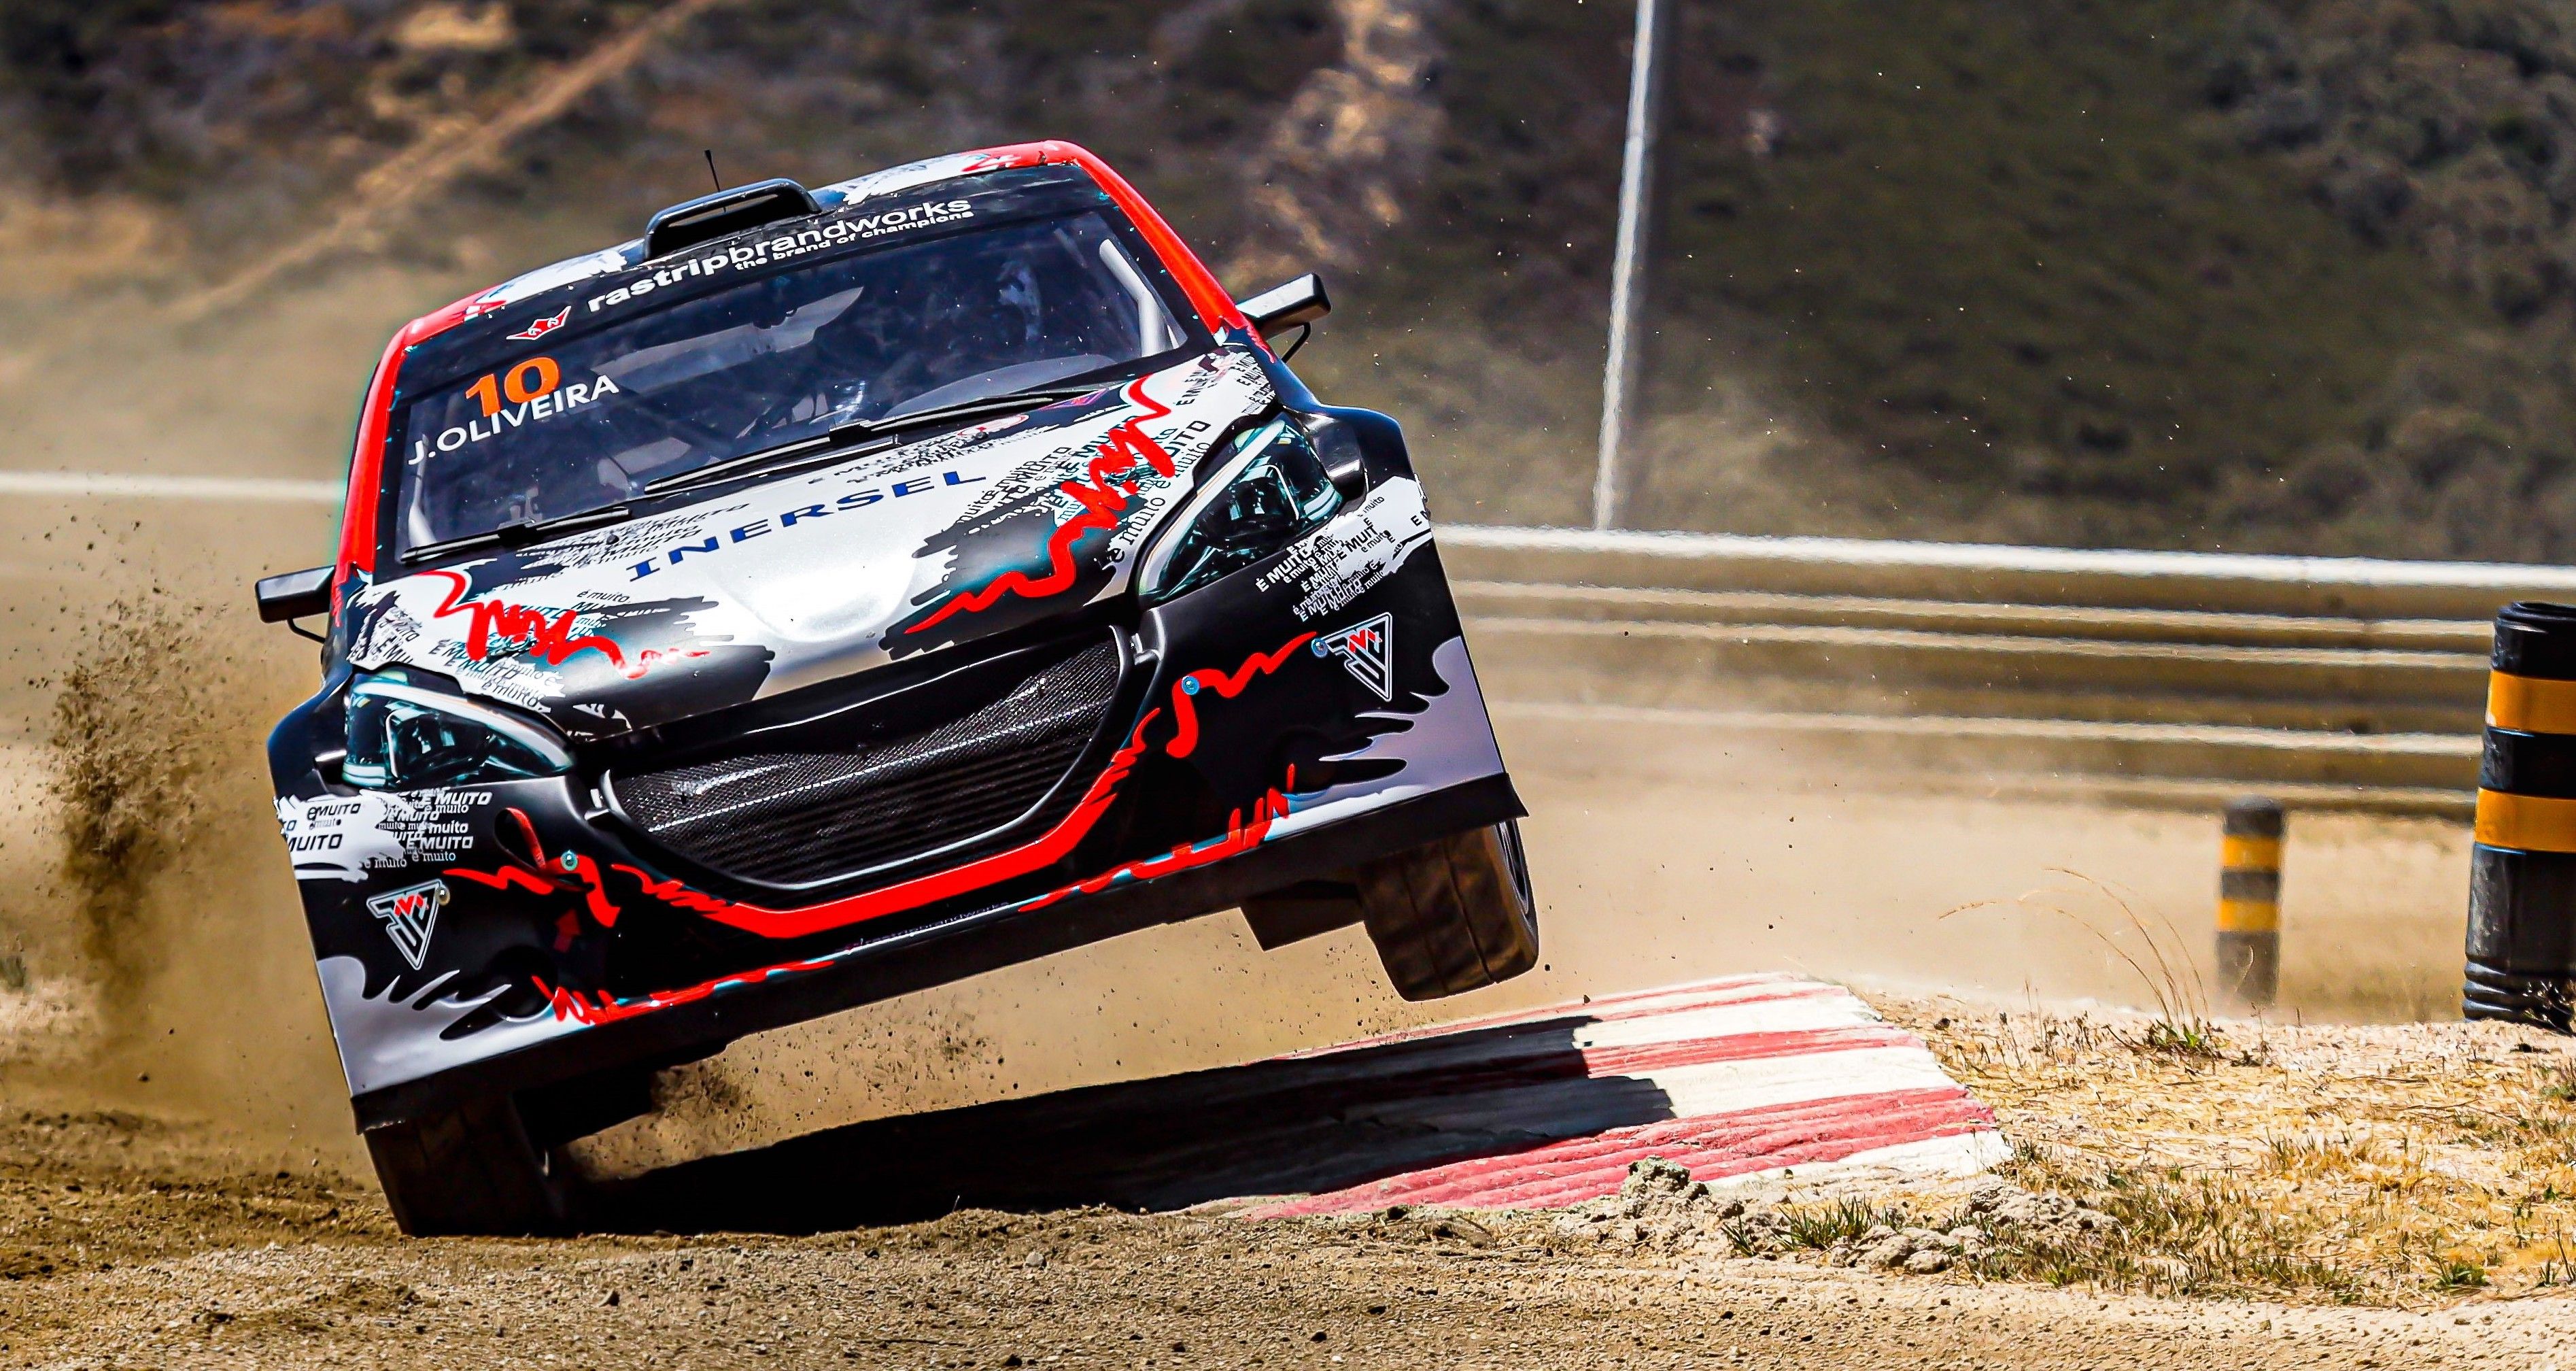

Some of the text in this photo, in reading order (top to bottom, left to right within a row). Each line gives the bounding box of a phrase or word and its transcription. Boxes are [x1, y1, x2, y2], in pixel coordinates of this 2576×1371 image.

[587, 199, 972, 313] rastripbrandworks
[735, 211, 974, 271] the brand of champions
[465, 356, 561, 418] 10
[408, 374, 619, 466] J.OLIVEIRA
[626, 471, 986, 583] INERSEL
[434, 791, 494, 806] MUITO
[419, 835, 475, 850] MUITO
[423, 849, 457, 862] muito
